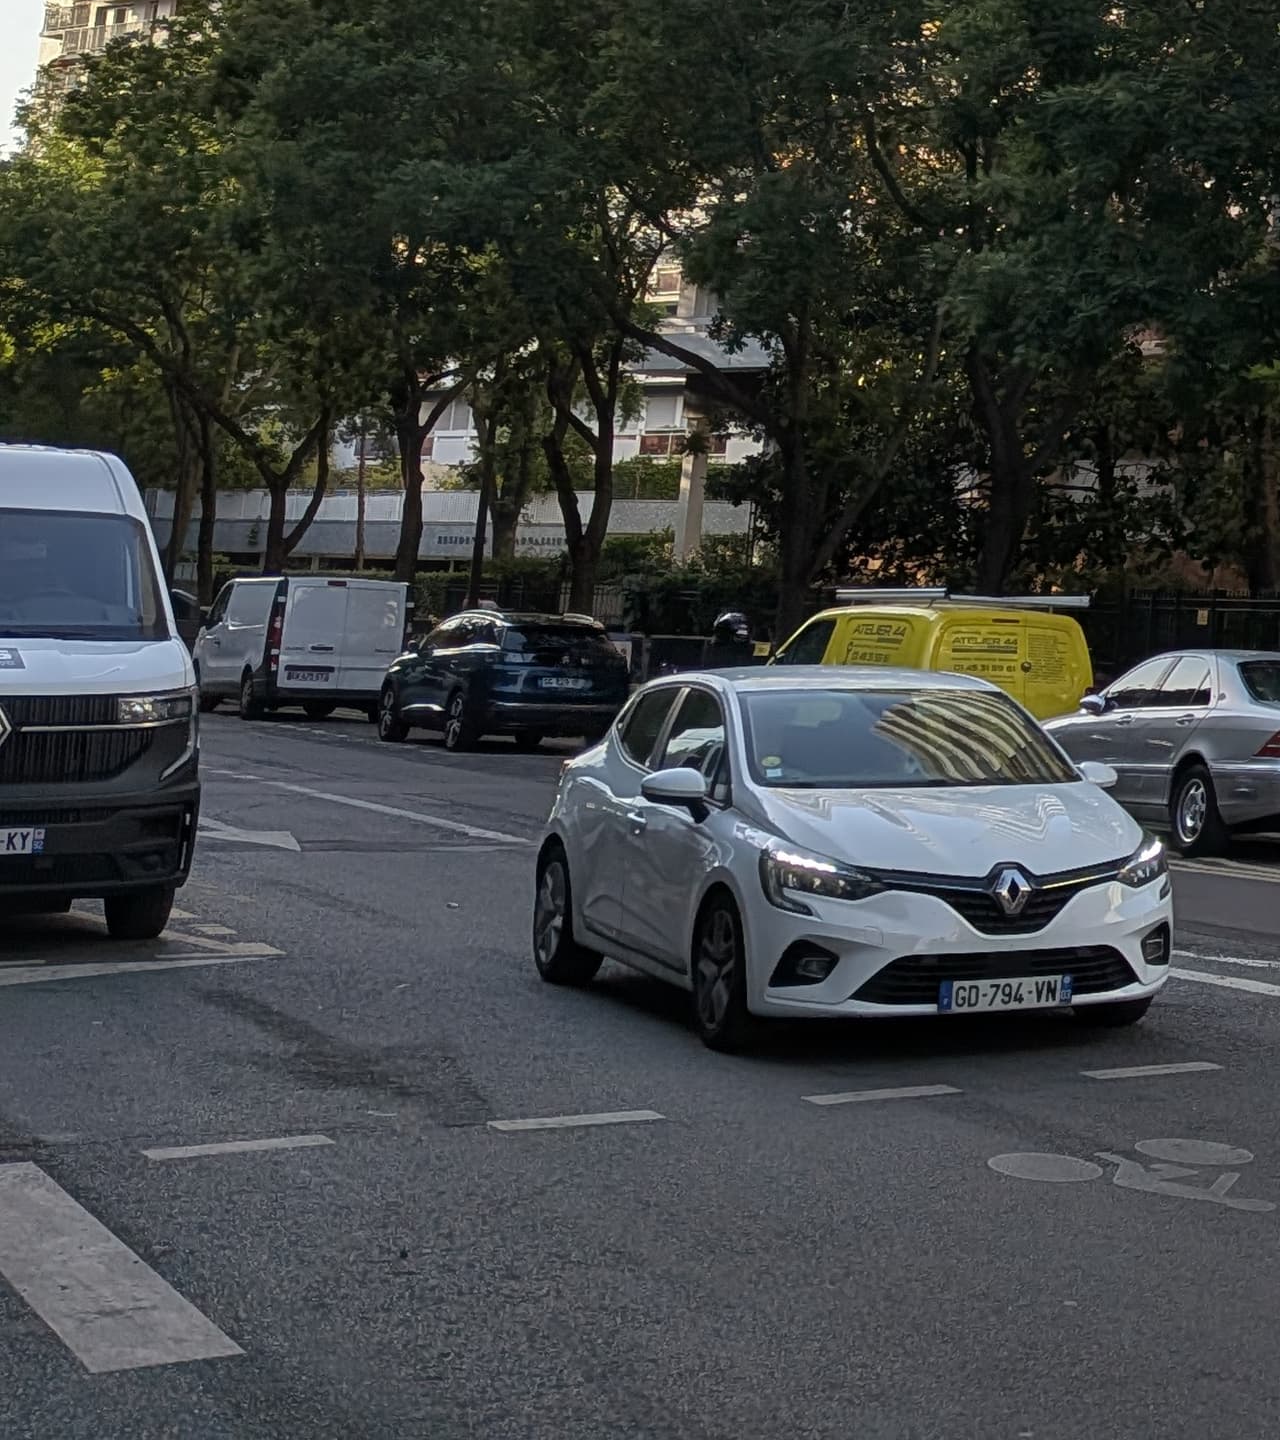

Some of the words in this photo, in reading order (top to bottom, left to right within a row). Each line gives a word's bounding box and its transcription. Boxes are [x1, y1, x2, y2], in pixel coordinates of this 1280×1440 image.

[852, 623, 893, 637] ATELIER
[893, 625, 907, 638] 44
[952, 636, 1001, 645] ATELIER
[1004, 638, 1018, 646] 44
[955, 980, 1057, 1007] GD-794-VN
